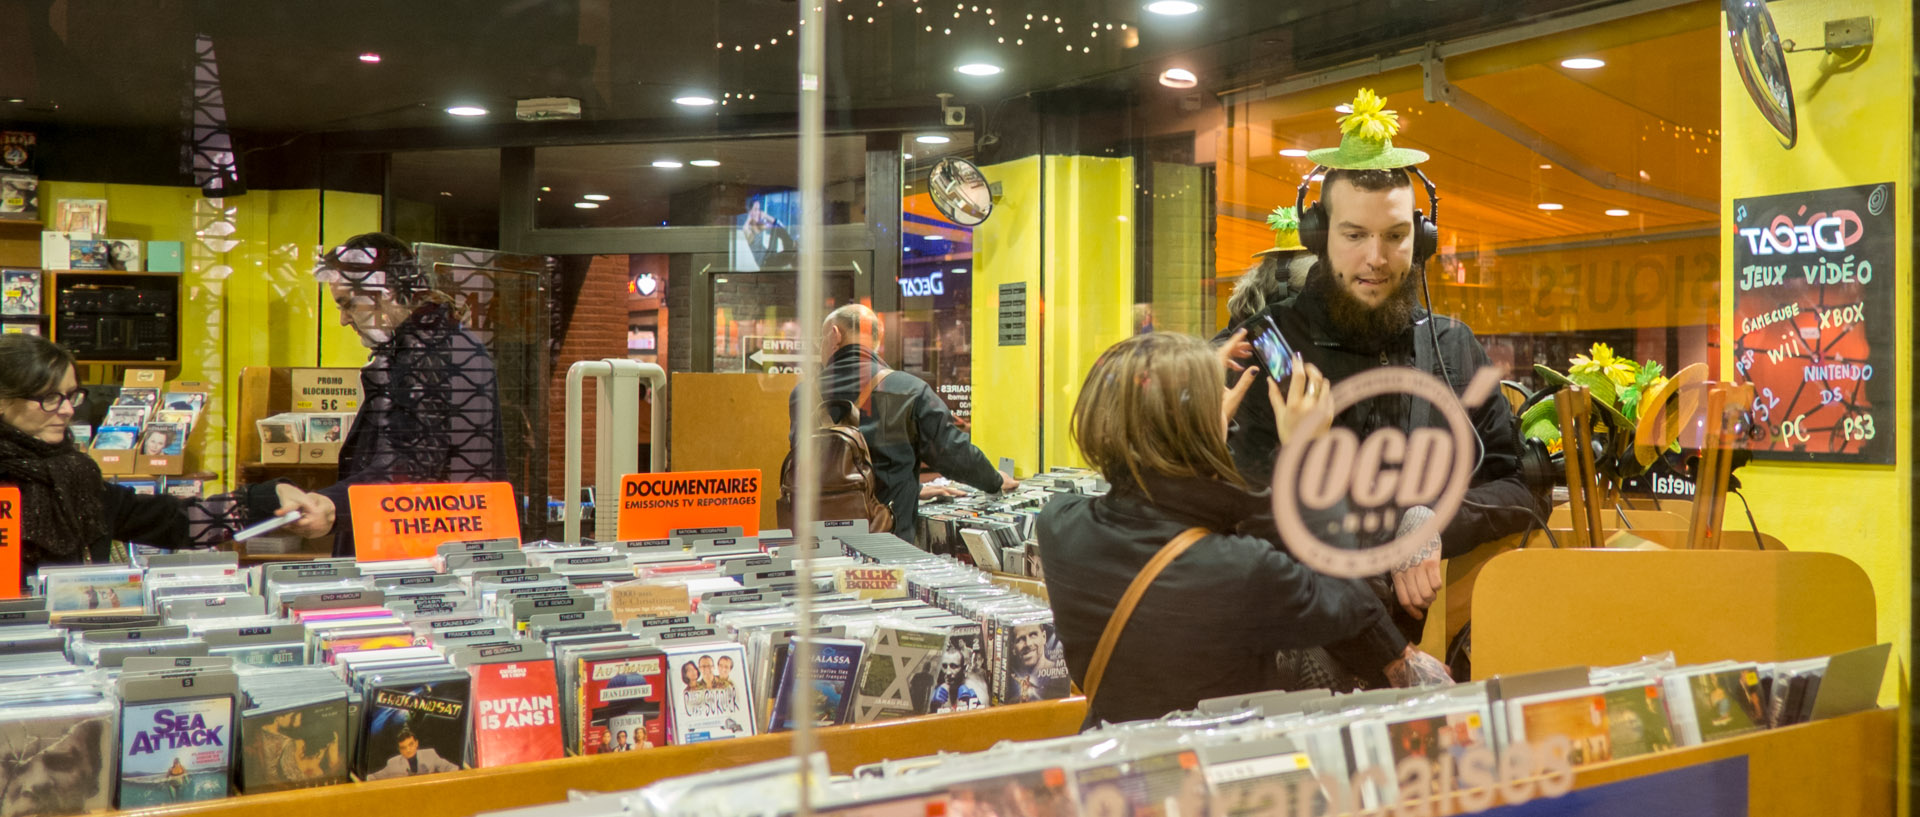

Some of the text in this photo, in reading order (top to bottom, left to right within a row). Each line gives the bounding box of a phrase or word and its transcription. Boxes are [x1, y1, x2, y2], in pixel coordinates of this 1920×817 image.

[1740, 265, 1787, 291] JEUX
[1742, 303, 1800, 334] GAMECUBE
[1819, 302, 1865, 330] XBOX
[1736, 350, 1755, 376] PSP
[317, 376, 343, 386] PROMO
[1804, 365, 1873, 382] NINTENDO
[302, 386, 357, 397] BLOCKBUSTERS
[1820, 387, 1843, 405] DS
[321, 399, 329, 410] 5
[1781, 415, 1810, 448] PC
[1843, 415, 1876, 440] PS3
[626, 477, 758, 497] DOCUMENTAIRES
[381, 495, 487, 513] COMIQUE
[625, 496, 757, 509] EMISSIONS TV REPORTAGES
[391, 516, 483, 534] THEATRE
[845, 569, 895, 580] KICK
[845, 579, 898, 590] BOXING
[806, 654, 851, 666] HALASSA
[1037, 666, 1069, 677] JOURNEY
[480, 695, 553, 715] PUTAIN
[153, 708, 206, 735] SEA
[480, 714, 501, 730] 15
[128, 725, 224, 756] ATTACK
